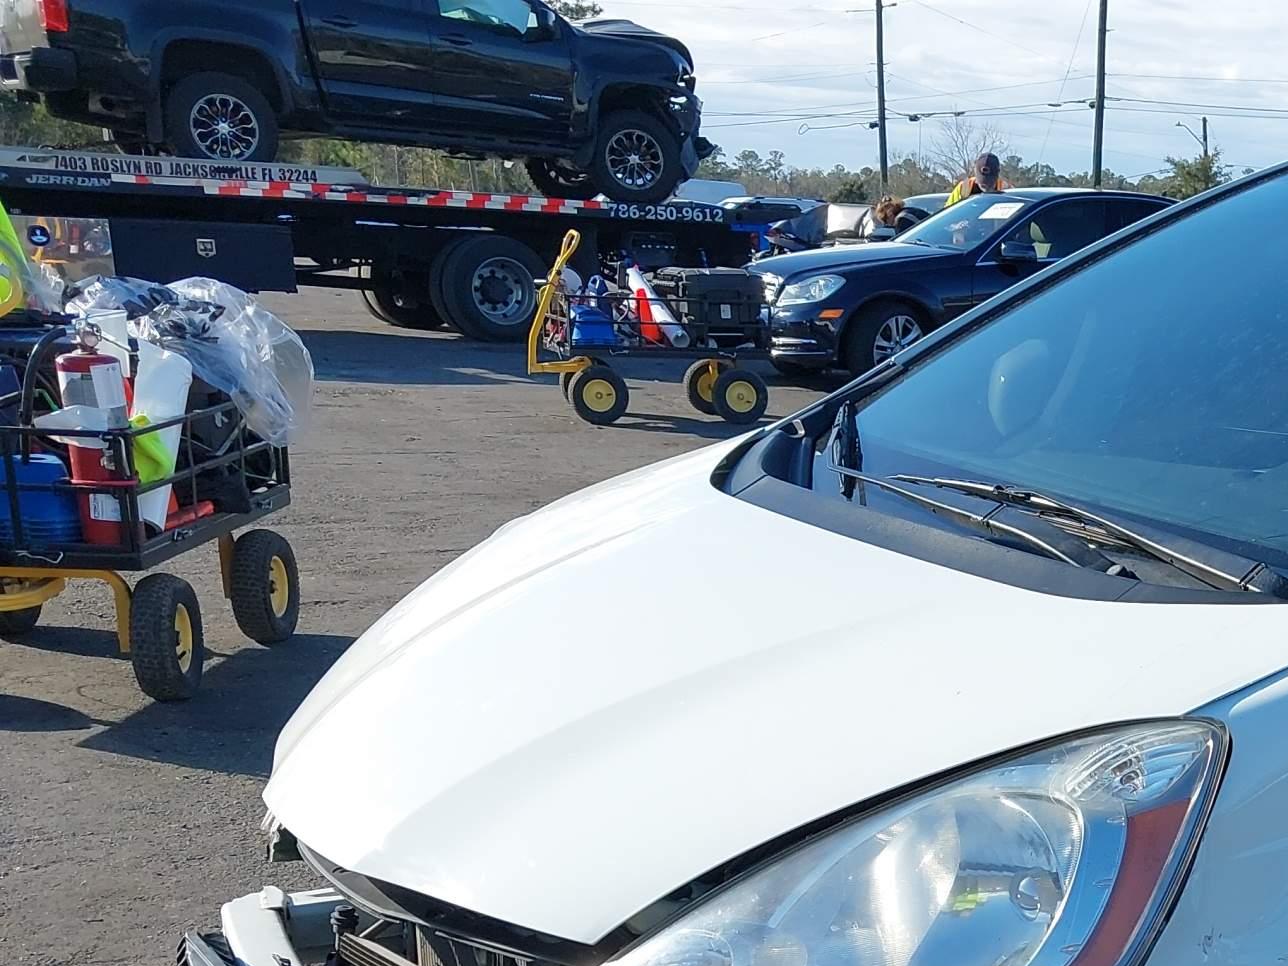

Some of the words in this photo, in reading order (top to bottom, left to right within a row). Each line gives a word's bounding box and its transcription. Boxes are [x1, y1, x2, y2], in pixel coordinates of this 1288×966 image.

[52, 155, 87, 170] 7403
[91, 157, 142, 174] ROSLYN
[145, 161, 163, 175] RD
[261, 167, 274, 181] FL
[278, 168, 318, 182] 32244
[607, 202, 724, 223] 786-250-9612
